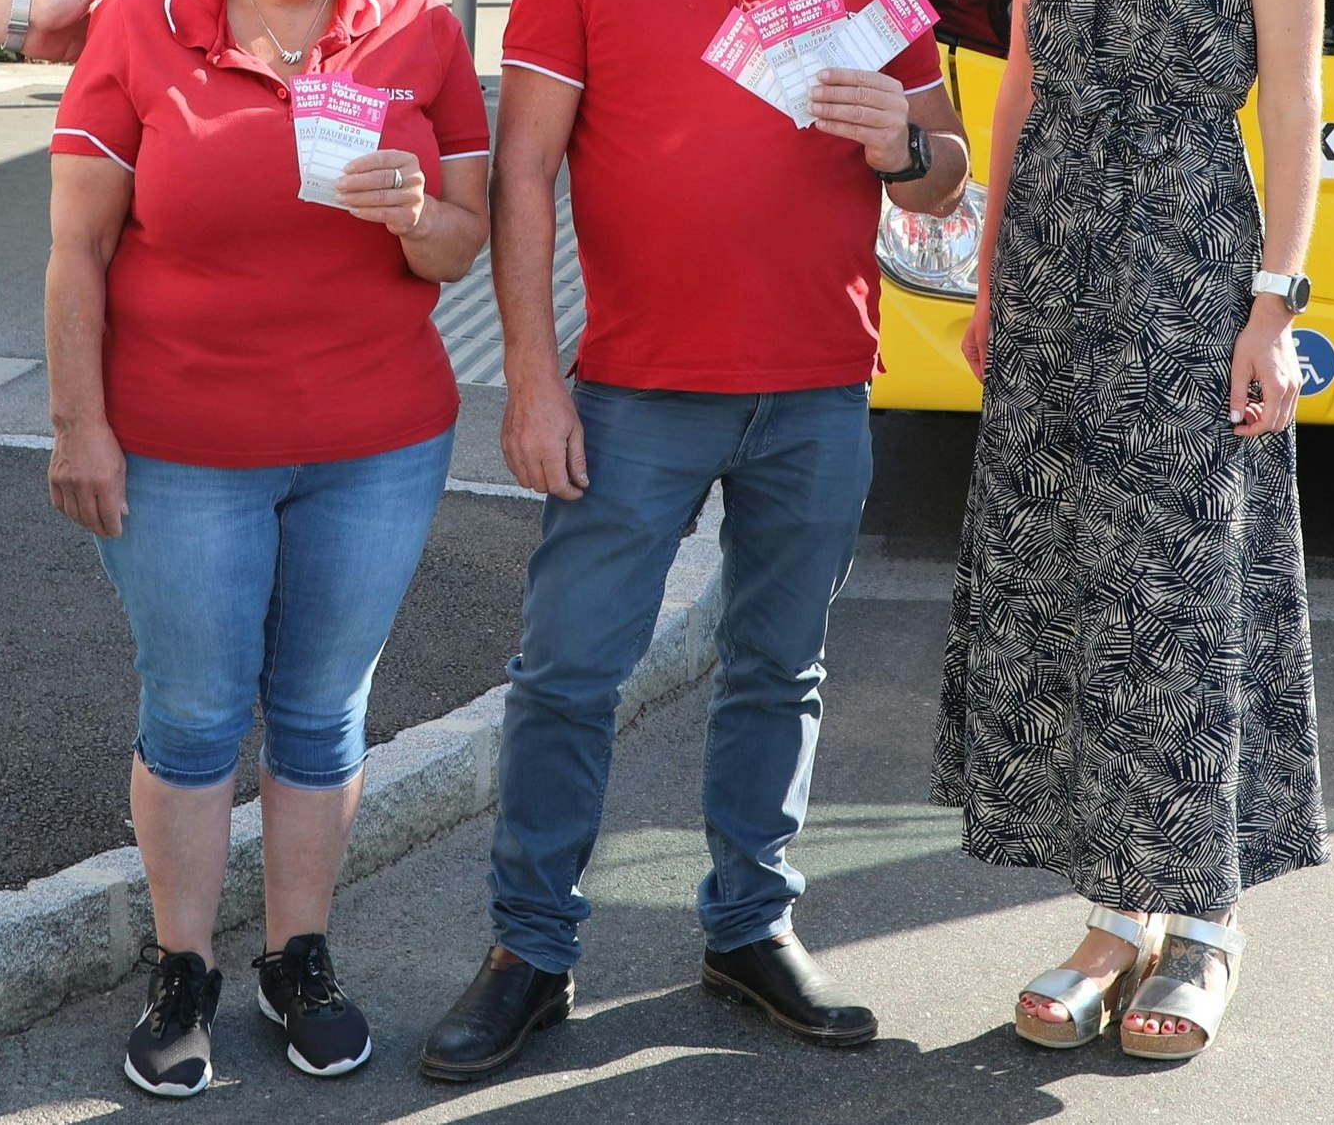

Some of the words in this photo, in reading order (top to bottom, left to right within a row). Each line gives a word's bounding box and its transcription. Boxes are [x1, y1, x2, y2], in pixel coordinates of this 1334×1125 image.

[810, 25, 831, 37] 2025
[711, 15, 746, 63] VOLKSFEST
[295, 82, 329, 93] VOLKS
[377, 87, 415, 101] USS
[296, 99, 325, 109] AUGUS
[331, 87, 386, 109] VOLKSFEST
[338, 125, 361, 136] 2025
[319, 129, 375, 149] DAUERKARTE
